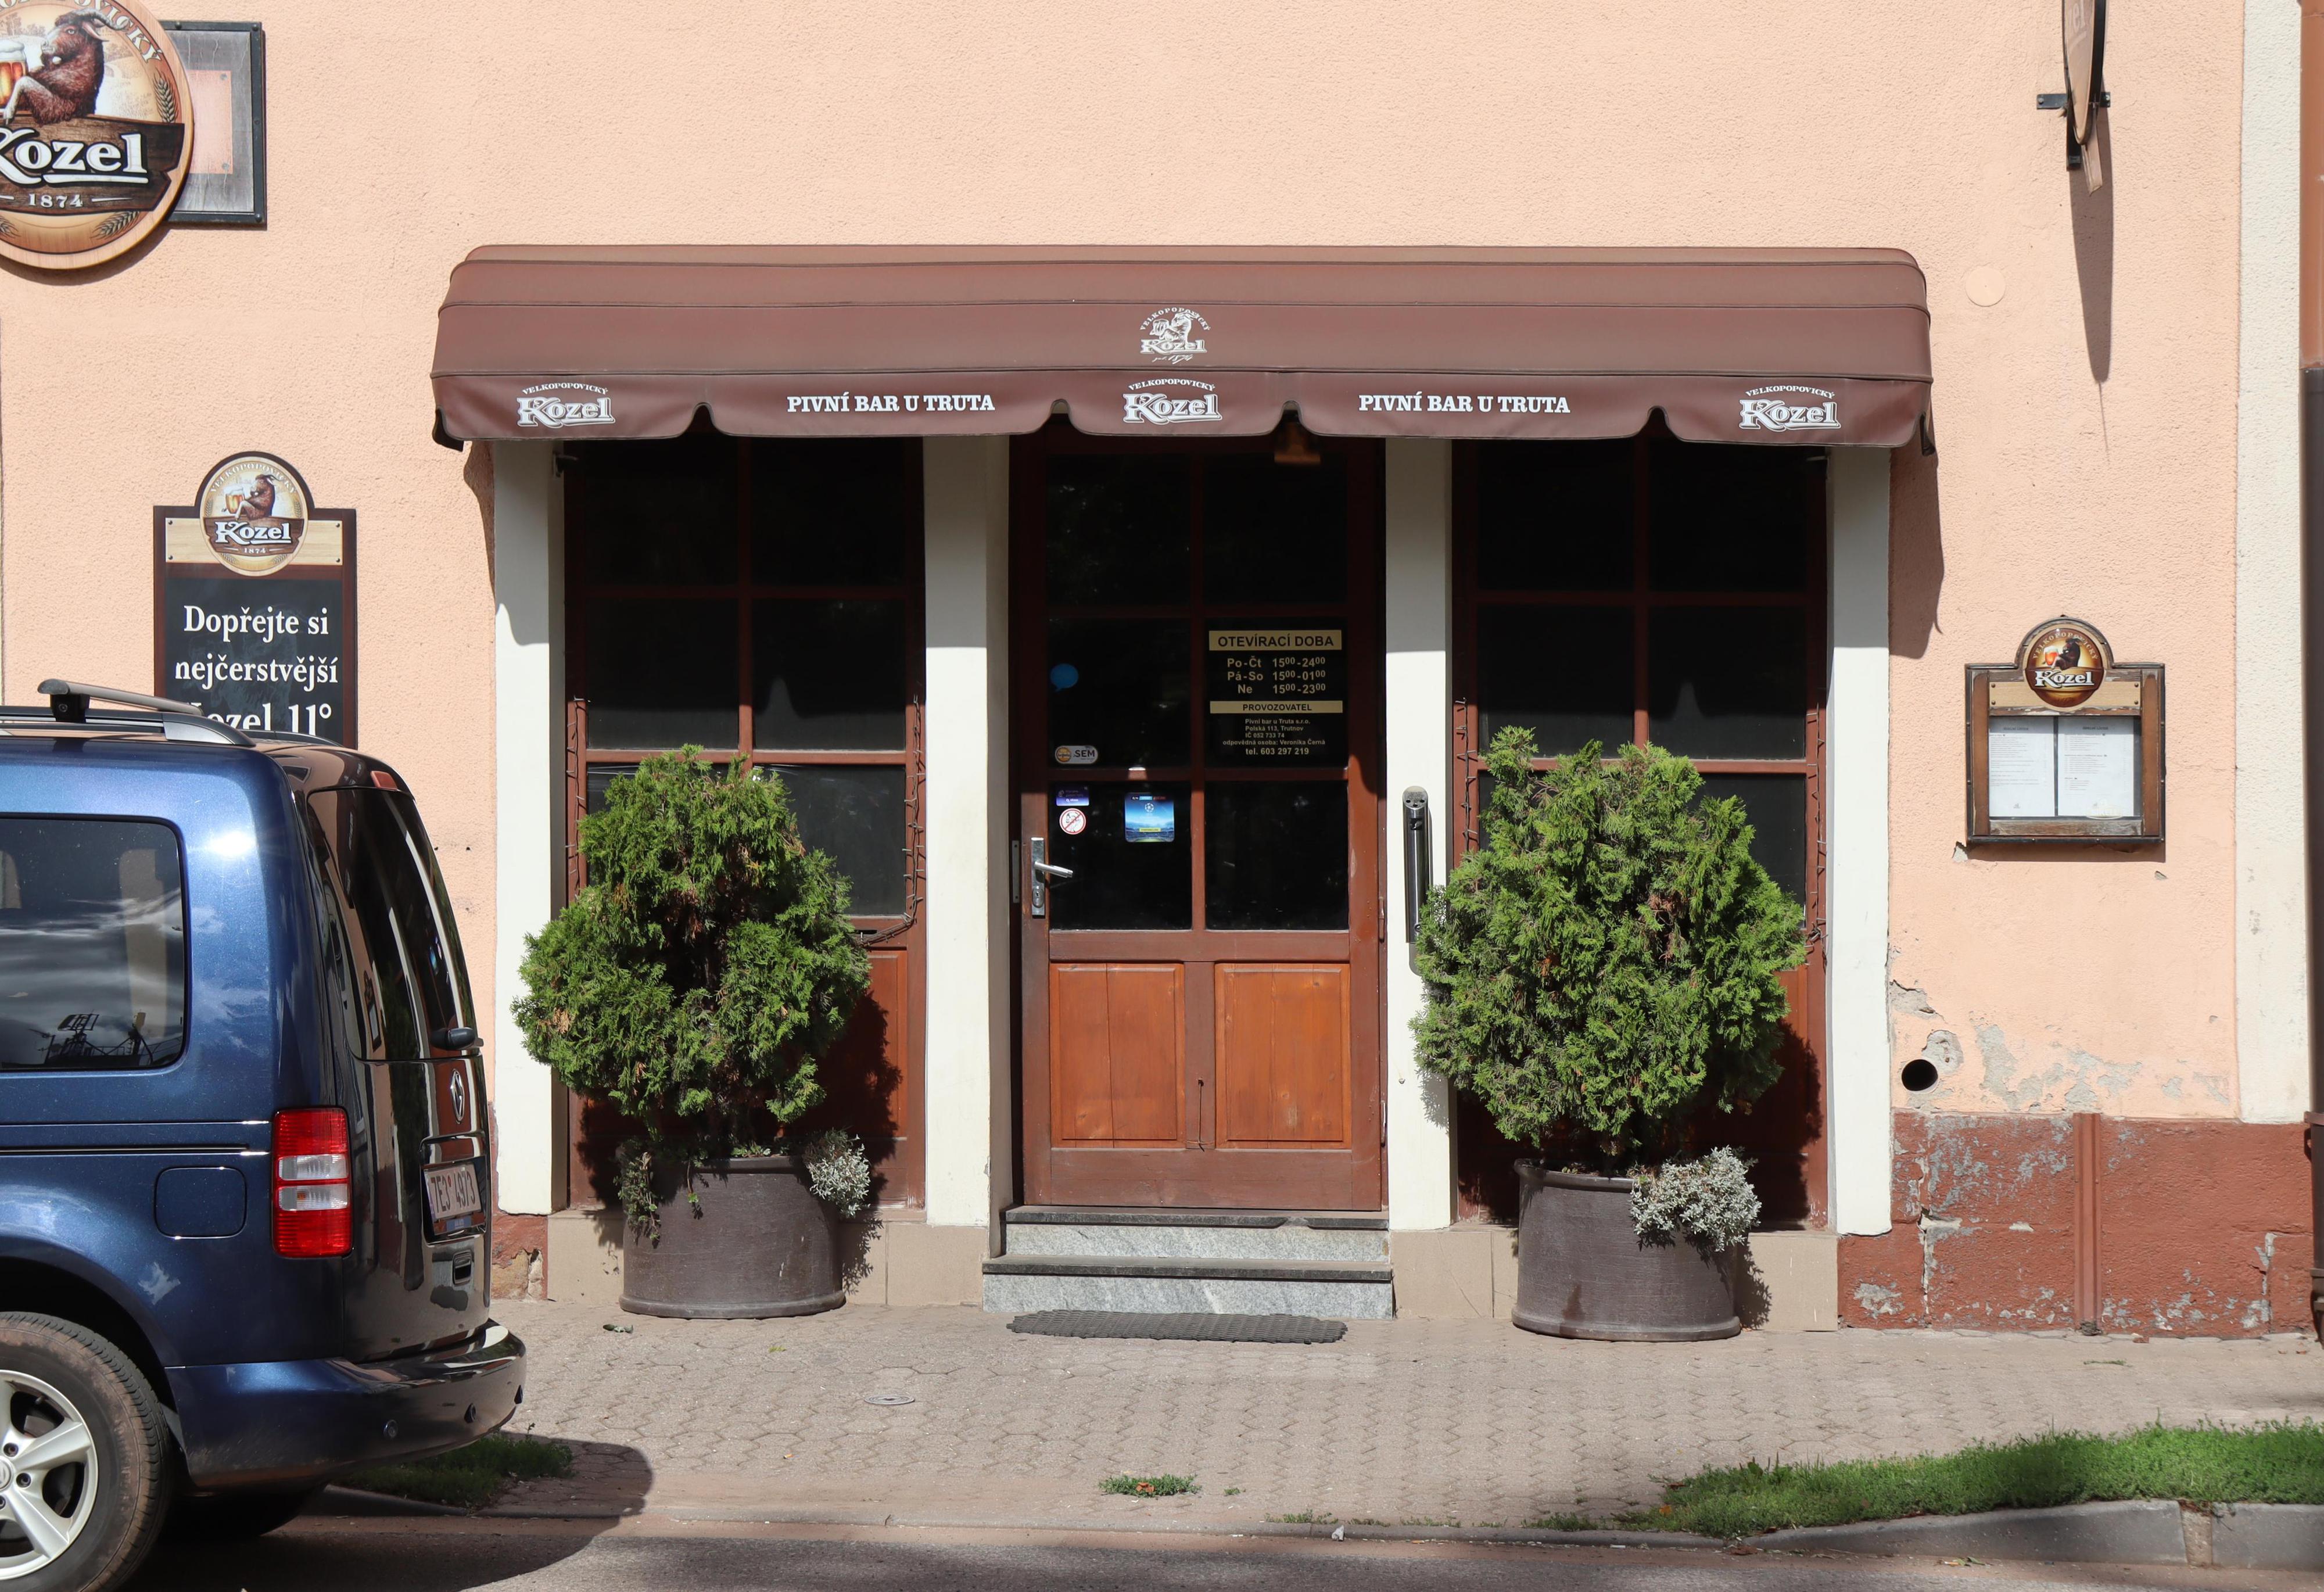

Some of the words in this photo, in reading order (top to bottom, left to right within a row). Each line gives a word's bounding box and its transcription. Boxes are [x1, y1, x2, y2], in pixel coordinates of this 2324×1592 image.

[28, 193, 84, 208] 1874
[1140, 339, 1207, 355] Kozel
[522, 382, 609, 395] VELKOPOPOVICKÝ
[1128, 378, 1215, 392] VELKOPOPOVICKÝ
[1745, 385, 1835, 399] VELKOPOPOVICKÝ
[517, 396, 616, 428] Kozel
[787, 392, 850, 413] PIVNÍ
[854, 396, 900, 413] BAR
[903, 395, 920, 412] U
[923, 395, 995, 411] TRUTA
[1122, 393, 1222, 425] Kozel
[1358, 391, 1423, 411] PIVNÍ
[1427, 395, 1473, 413] BAR
[1477, 396, 1494, 413] U
[1497, 396, 1570, 414] TRUTA
[1738, 399, 1841, 432] Kozel
[214, 521, 292, 545] Kozel
[184, 605, 299, 643] Dopřejte
[307, 608, 329, 635] si
[1218, 633, 1290, 647] OTEVÍRACÍ
[1294, 636, 1334, 647] DOBA
[175, 652, 339, 692] nejčerstvější
[2035, 670, 2095, 689] Kozel
[1238, 684, 1253, 694] Ne
[288, 703, 332, 736] 11°
[431, 1174, 451, 1213] 7E3
